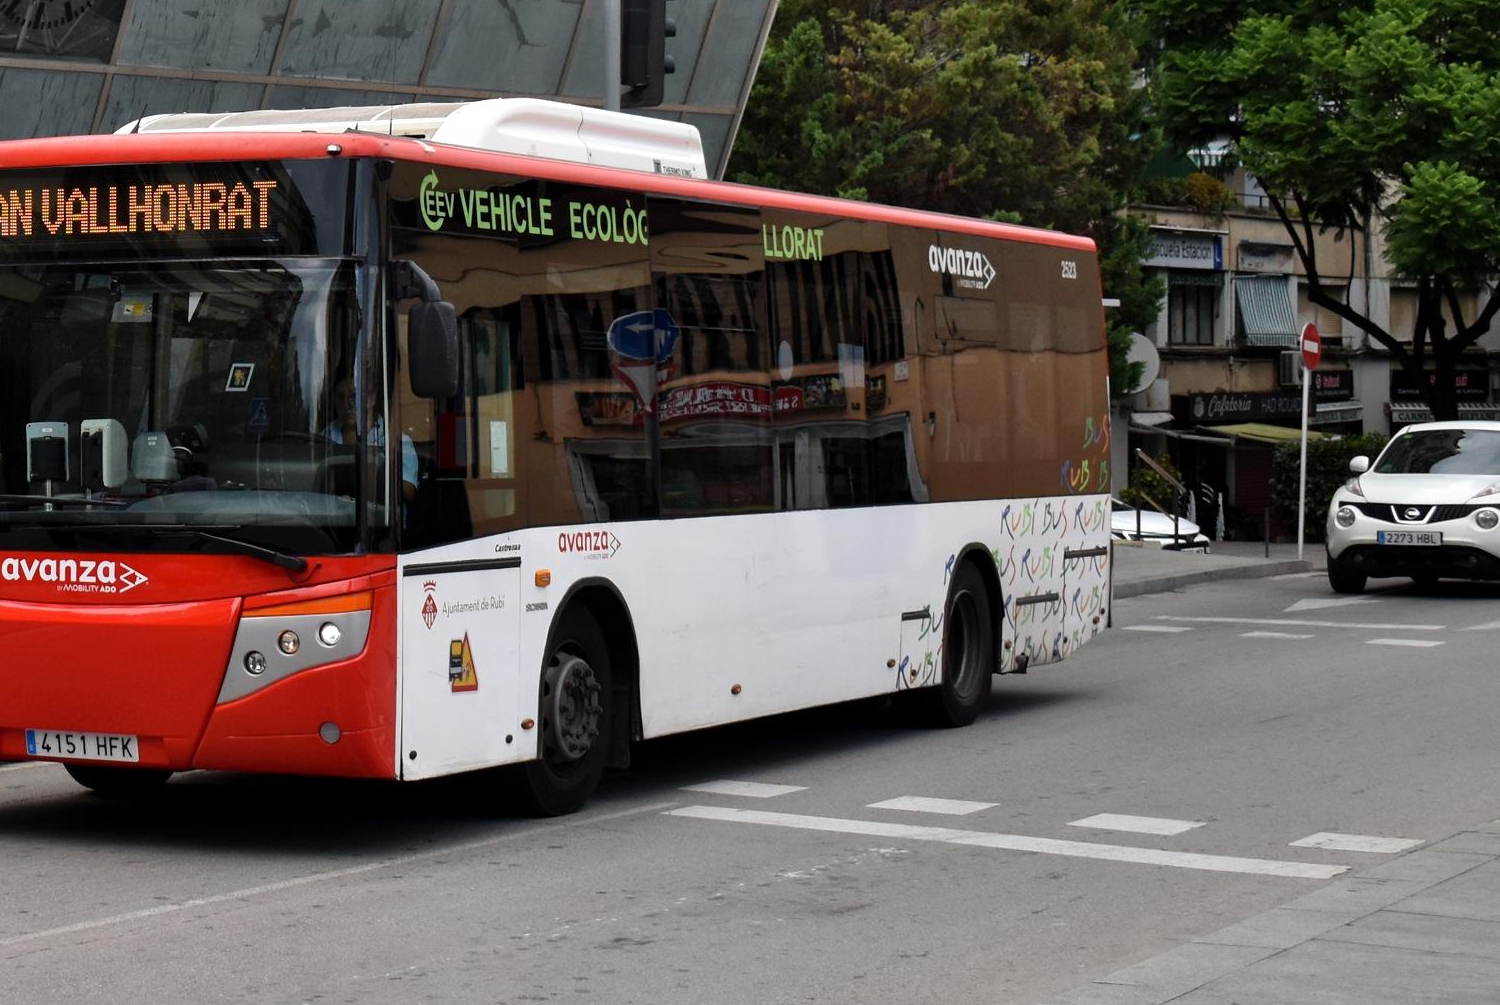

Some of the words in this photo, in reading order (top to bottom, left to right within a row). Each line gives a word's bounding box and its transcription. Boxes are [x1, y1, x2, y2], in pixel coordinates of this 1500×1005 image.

[41, 180, 278, 235] VALLHONRAT
[425, 189, 455, 219] EEV
[459, 187, 554, 237] VEHICLE
[762, 223, 825, 262] LLORAT
[929, 244, 984, 278] avanza
[1061, 260, 1077, 279] 2523
[558, 530, 609, 553] avanza
[1387, 532, 1414, 544] 2273
[1417, 533, 1437, 545] HBL
[1, 557, 117, 584] avanza
[63, 584, 99, 592] MOBILITY
[442, 598, 481, 619] Ajuntament
[482, 598, 489, 610] de
[490, 595, 506, 609] Rubí
[41, 733, 87, 756] 4151
[96, 735, 133, 758] HFK
